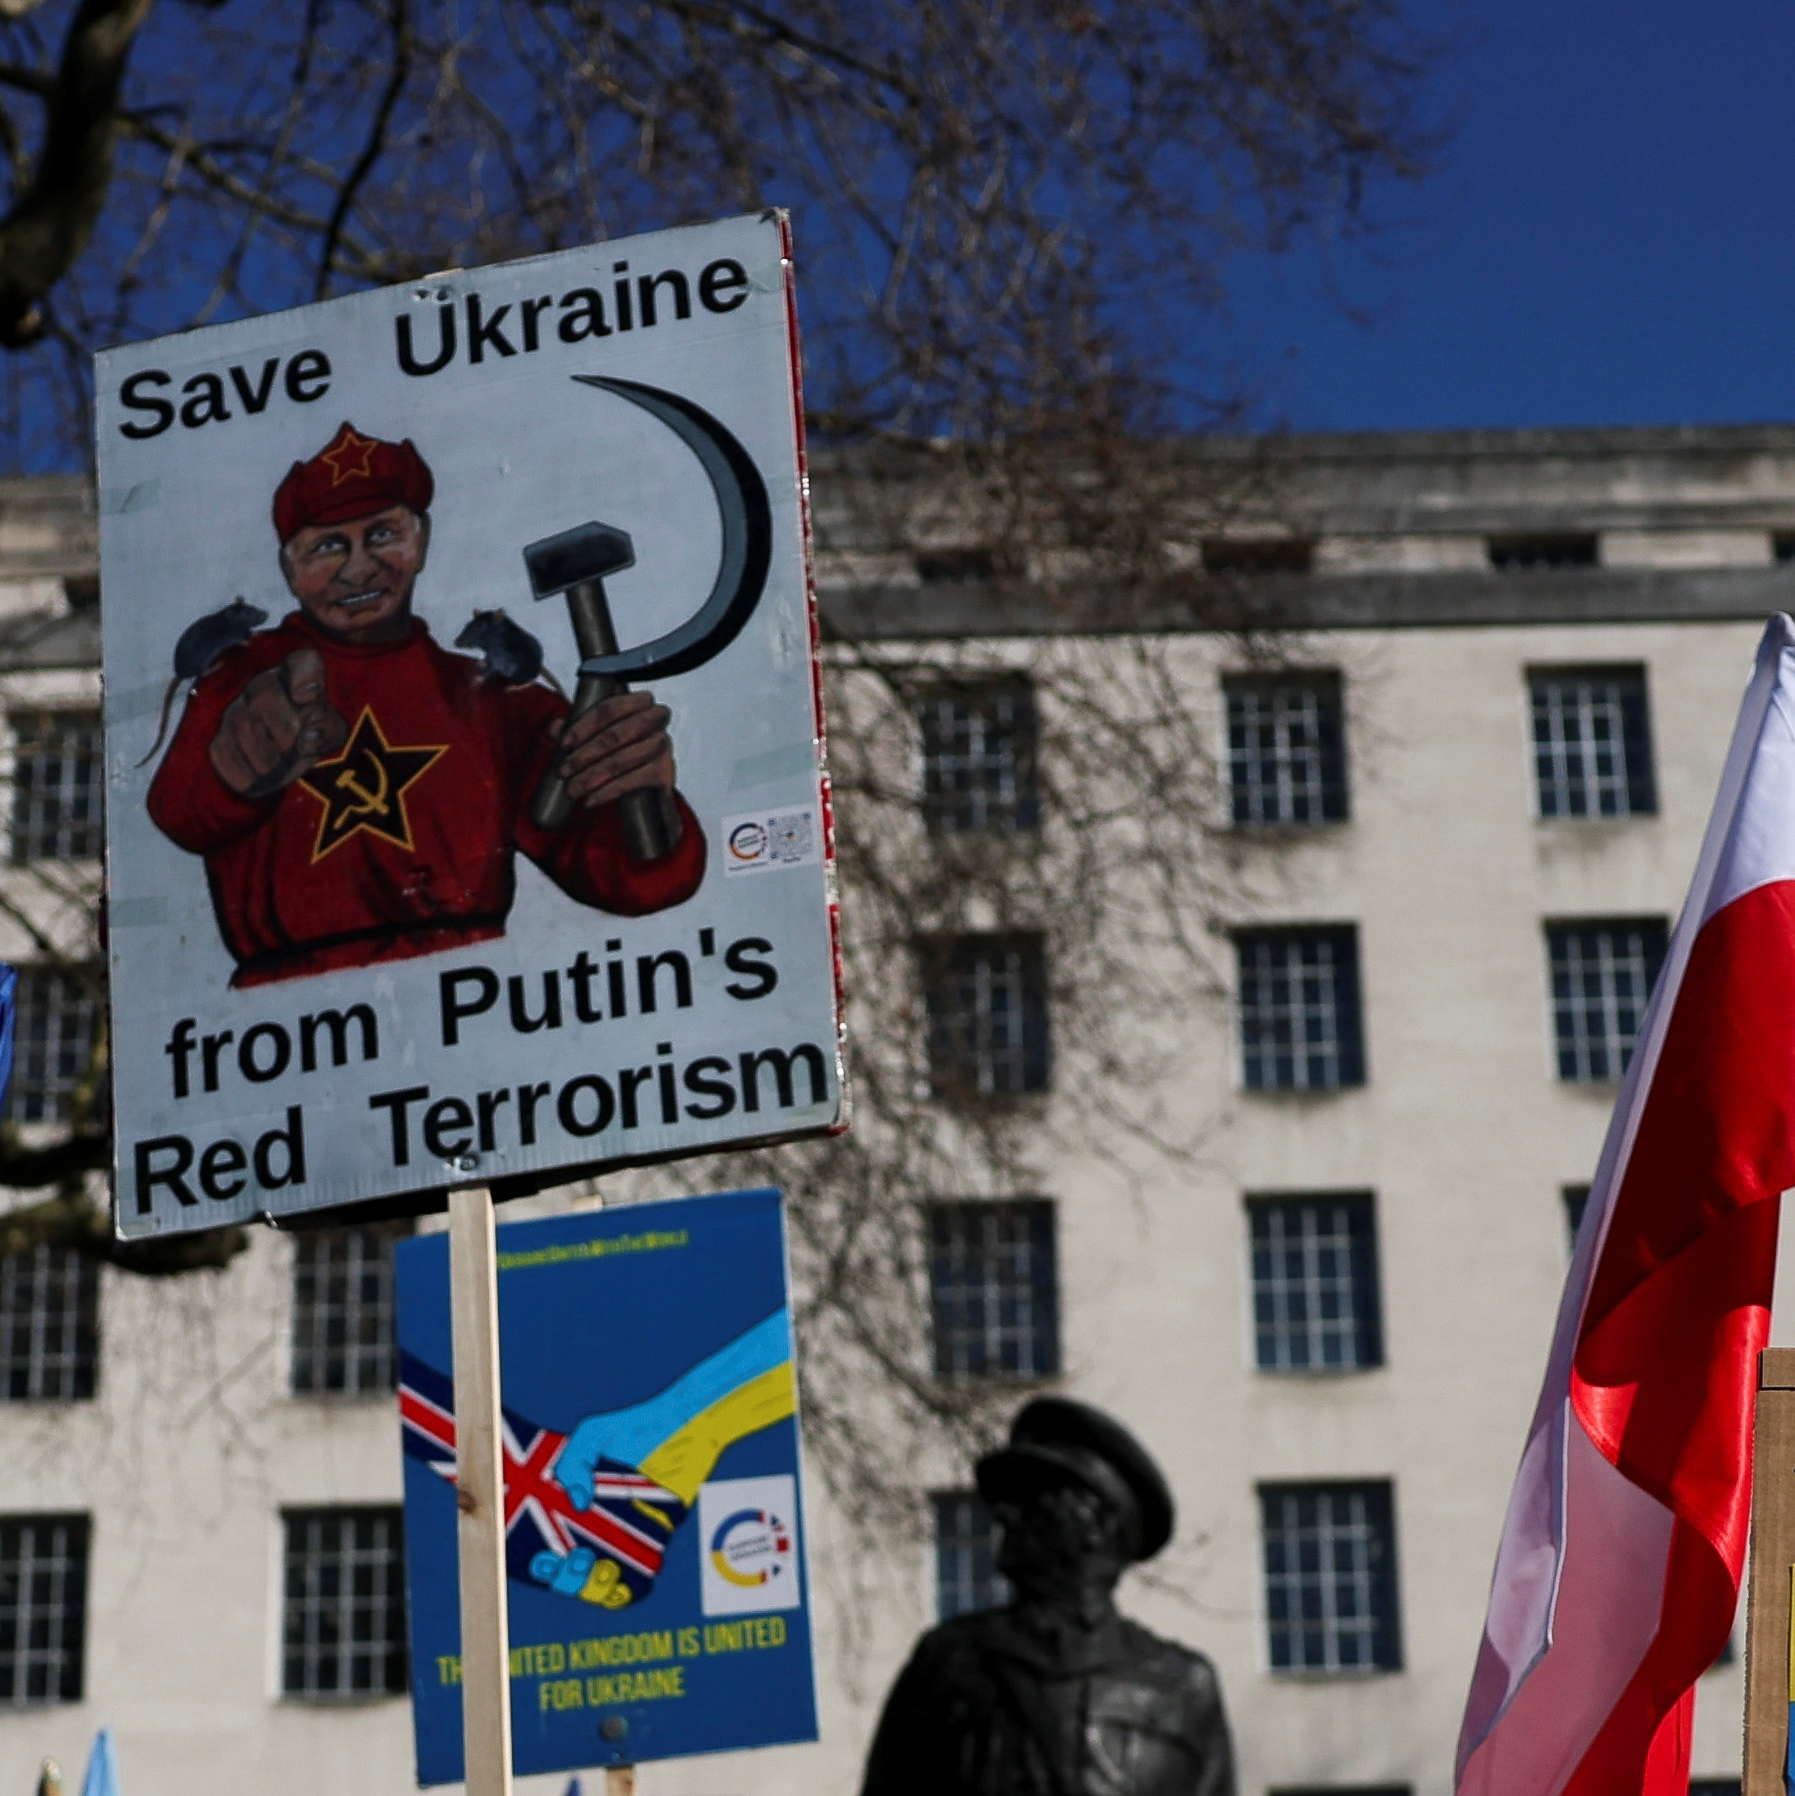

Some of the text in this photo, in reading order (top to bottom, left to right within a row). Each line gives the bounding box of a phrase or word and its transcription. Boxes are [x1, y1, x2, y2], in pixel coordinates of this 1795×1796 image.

[118, 255, 749, 441] Save Ukraine
[165, 930, 779, 1100] from Putin's
[133, 1041, 829, 1214] Red Terrorism
[436, 1616, 787, 1686] TH NITED KINGDOM IS UNITED
[538, 1666, 685, 1712] FOR UKRAINE
